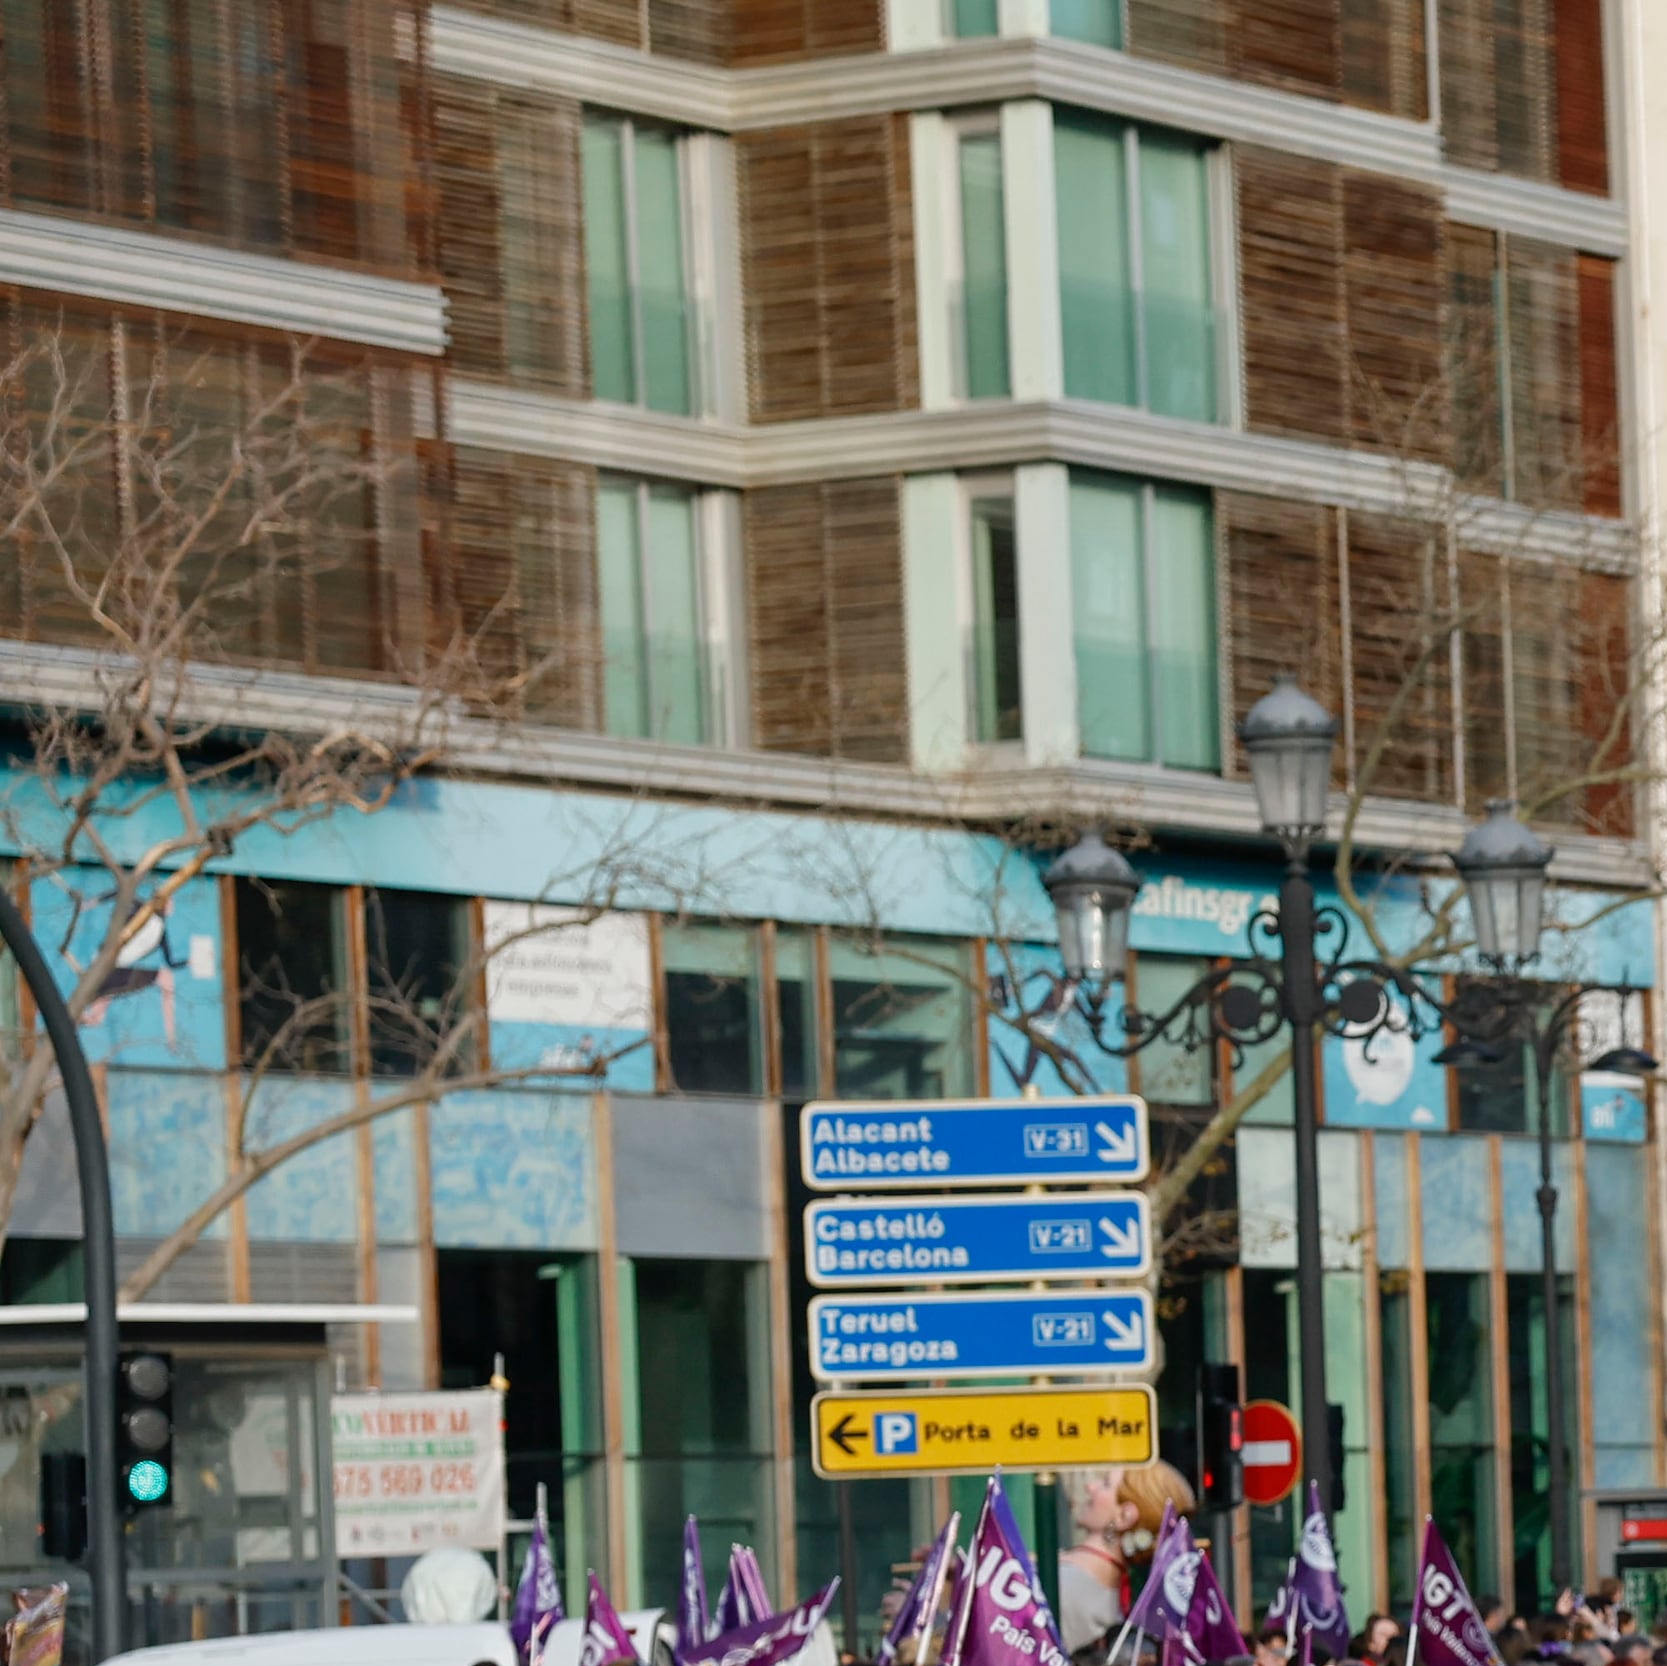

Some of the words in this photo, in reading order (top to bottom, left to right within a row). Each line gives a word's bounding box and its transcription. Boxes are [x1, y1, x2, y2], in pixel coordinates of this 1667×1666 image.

[814, 1116, 934, 1144] Alacant
[1030, 1129, 1083, 1152] V-31
[814, 1147, 951, 1175] Albacete
[816, 1212, 946, 1242] Castelló
[1037, 1226, 1088, 1249] V-21
[817, 1247, 970, 1272] Barcelona
[822, 1307, 919, 1335] Teruel
[1040, 1318, 1091, 1341] V-21
[821, 1339, 959, 1367] Zaragoza
[883, 1416, 912, 1453] P
[924, 1420, 991, 1443] Porta
[1010, 1418, 1040, 1440] de
[1058, 1418, 1079, 1439] la
[1098, 1417, 1145, 1438] Mar
